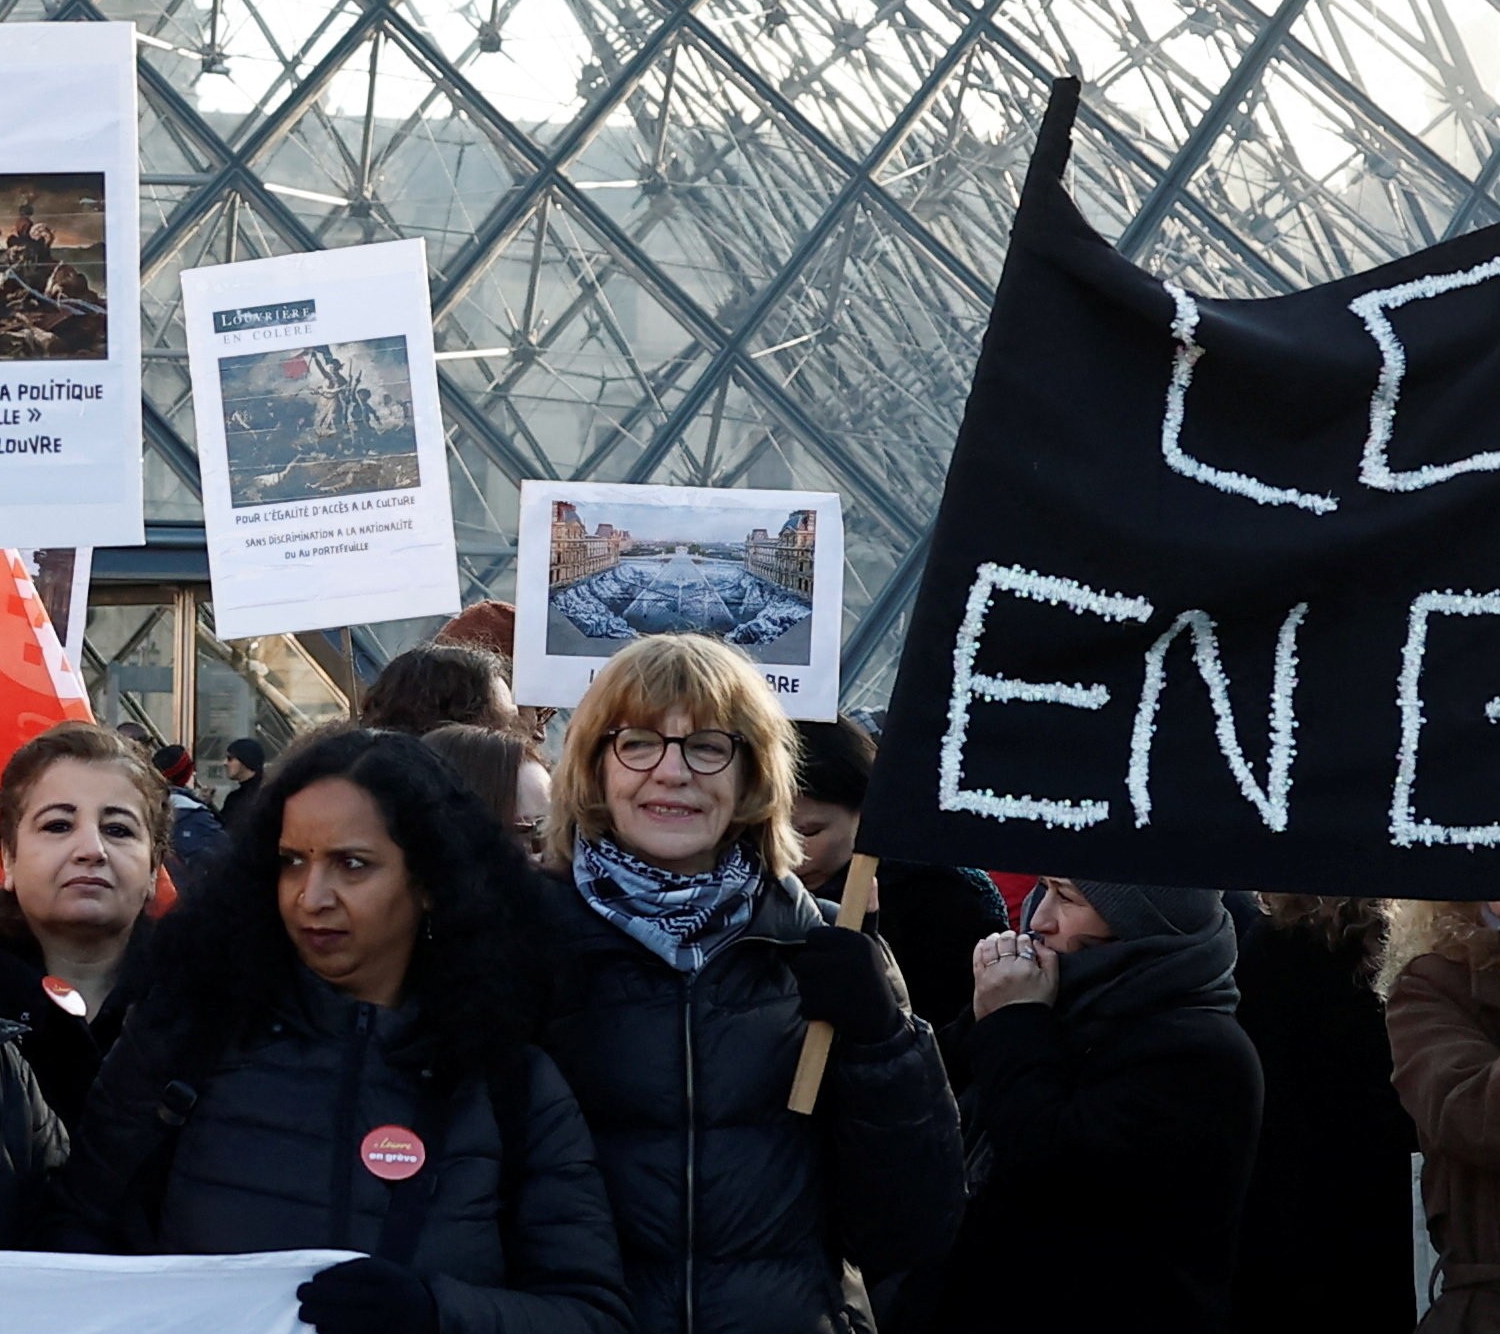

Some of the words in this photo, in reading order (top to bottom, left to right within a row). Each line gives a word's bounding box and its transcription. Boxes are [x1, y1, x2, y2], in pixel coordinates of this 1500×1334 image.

[223, 333, 242, 345] EN
[18, 378, 104, 402] POLITIQUE
[235, 512, 261, 525] POUR
[361, 499, 374, 511] LA
[376, 495, 416, 508] CULTURE
[346, 525, 357, 536] LA
[285, 549, 296, 560] OU
[299, 548, 310, 559] AU
[939, 562, 1308, 833] EN
